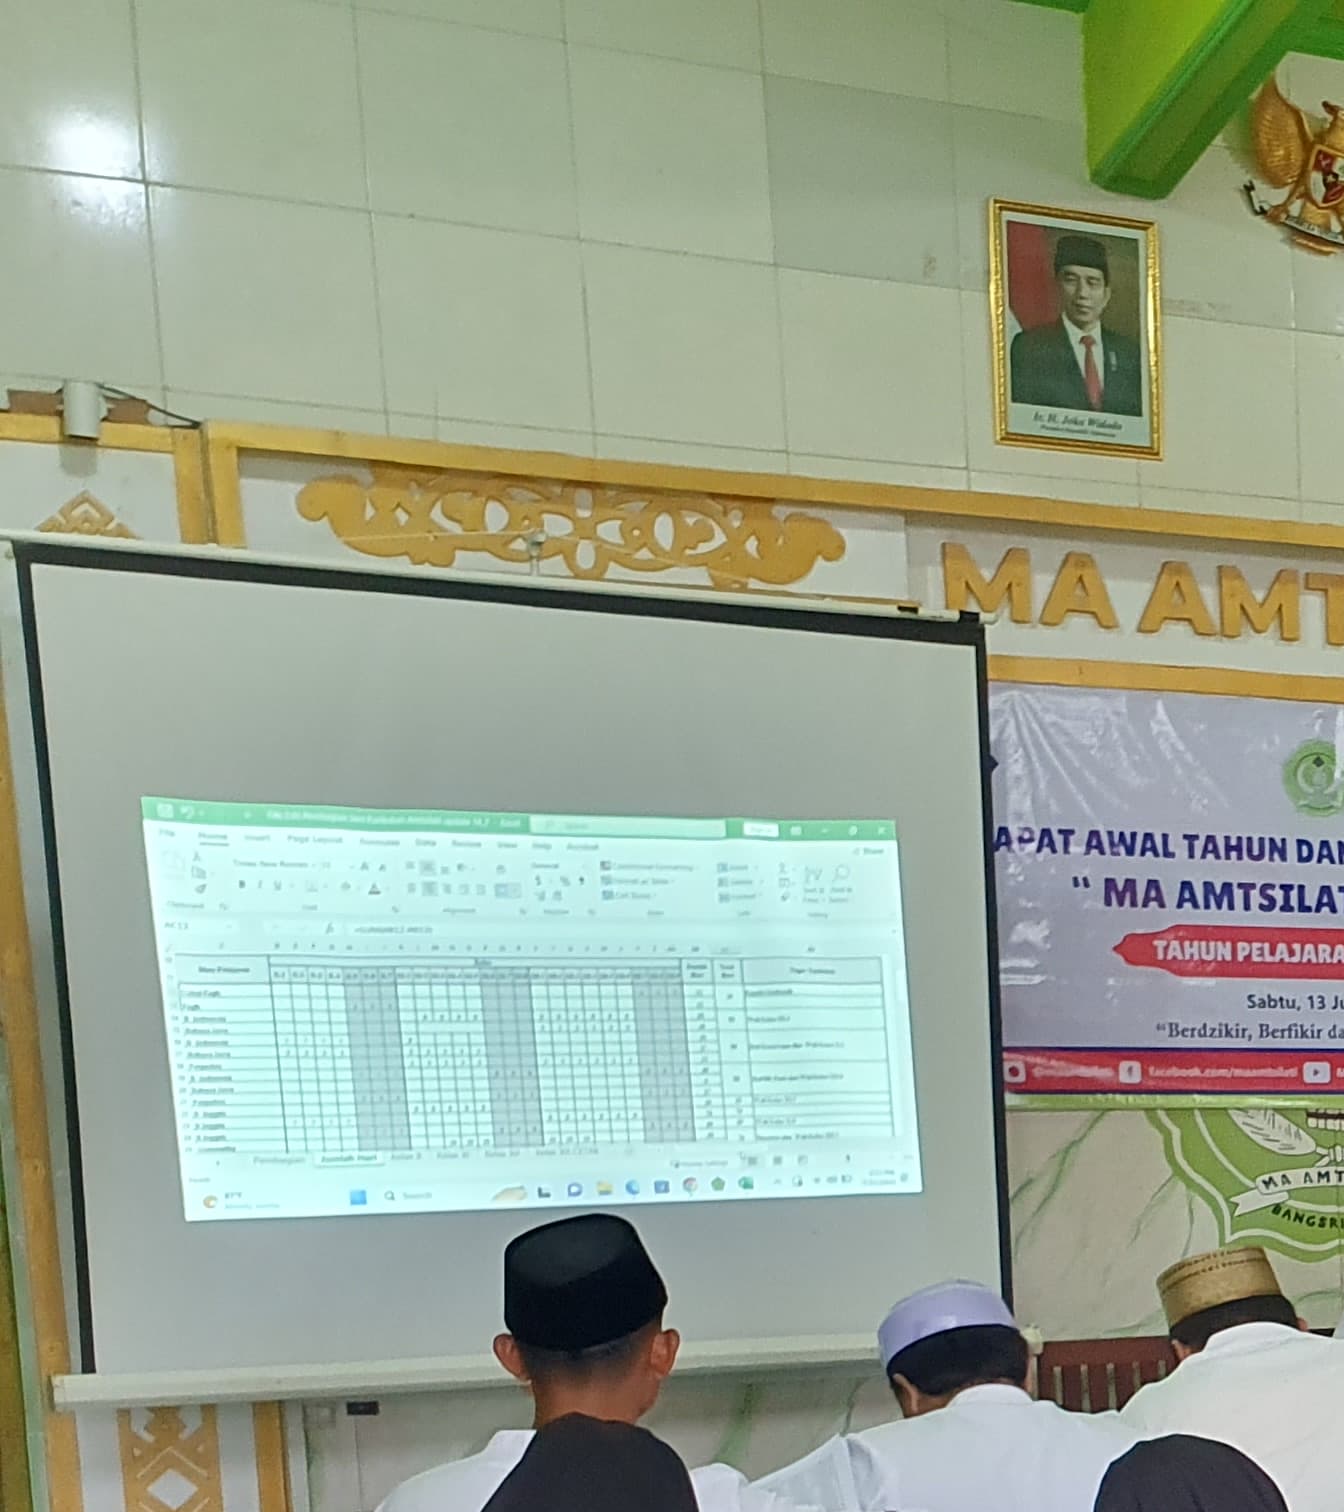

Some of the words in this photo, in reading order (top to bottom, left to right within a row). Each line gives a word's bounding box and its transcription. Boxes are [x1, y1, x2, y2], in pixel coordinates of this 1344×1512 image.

[941, 543, 1119, 629] MA
[993, 827, 1076, 854] APAT
[1084, 830, 1175, 859] AWAL
[1183, 834, 1287, 862] TAHUN
[1104, 878, 1167, 908] MA
[1153, 940, 1231, 961] TAHUN
[1247, 995, 1301, 1011] Sabtu,
[1308, 995, 1326, 1009] 13
[1258, 1023, 1323, 1039] Berfikir
[1262, 1174, 1291, 1190] MA
[1272, 1205, 1344, 1229] BANGSRI
